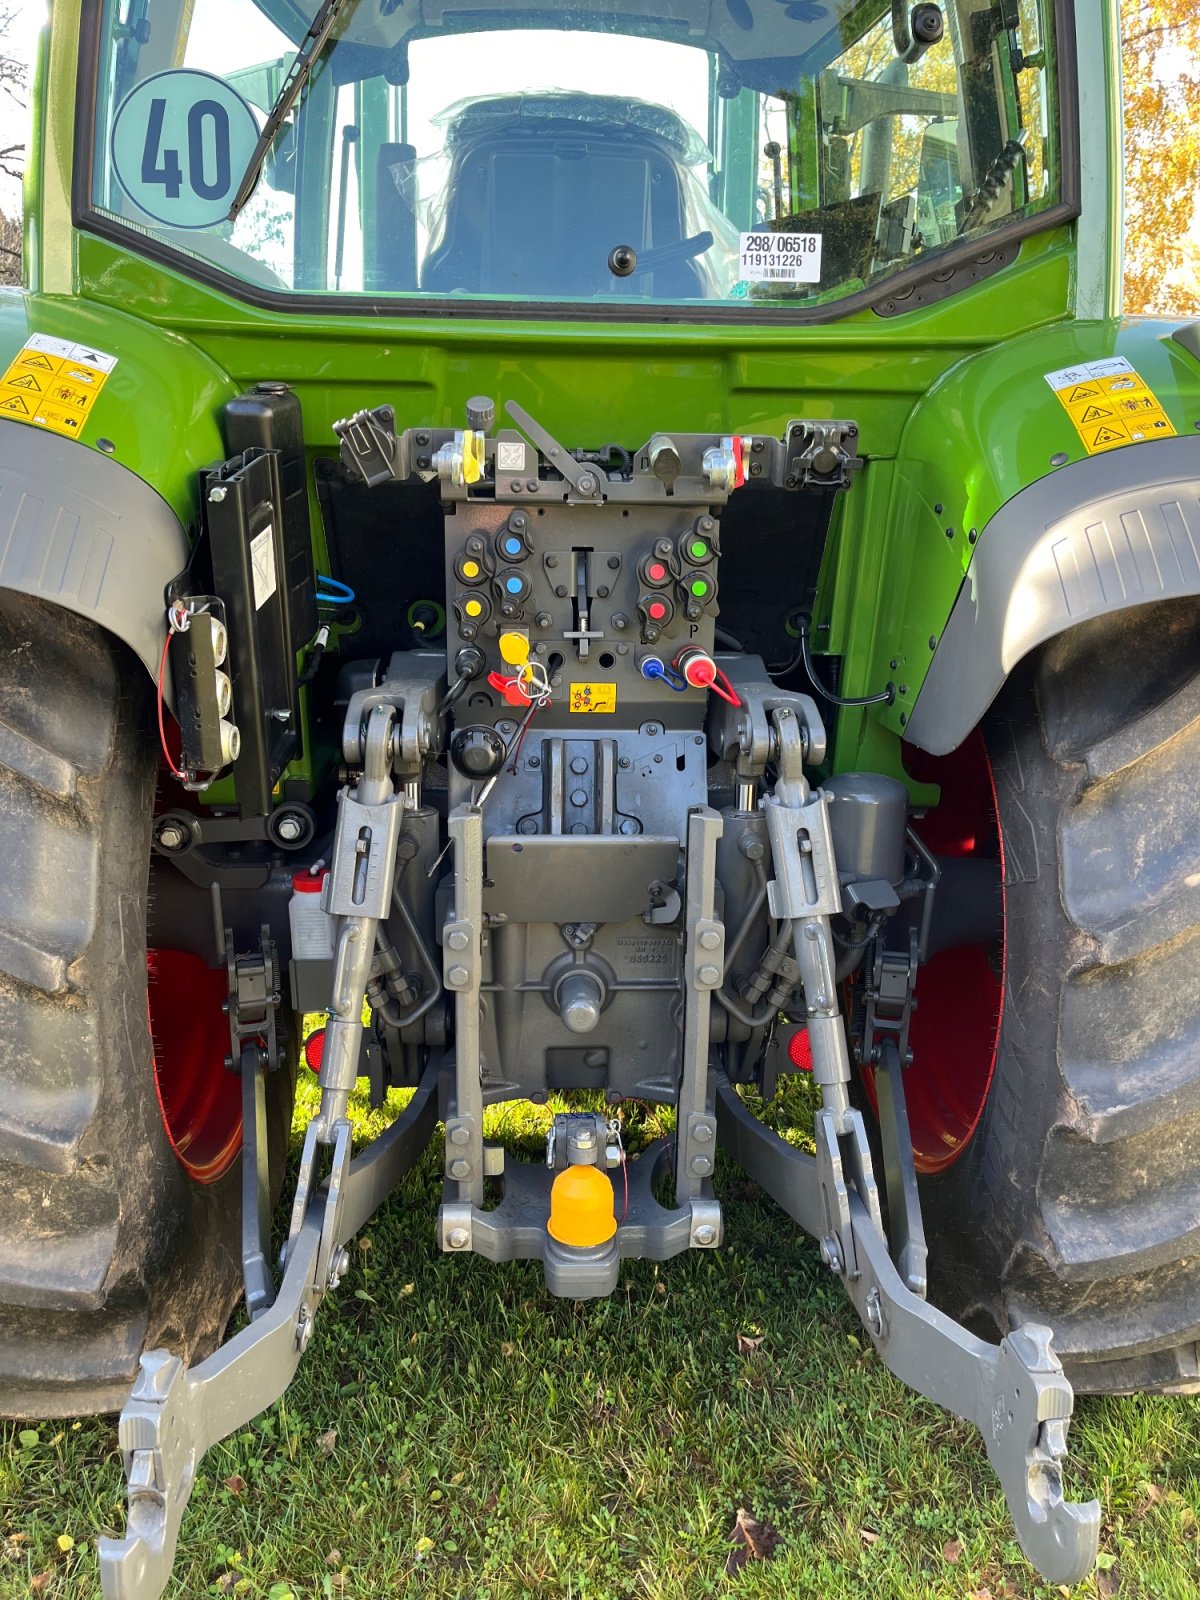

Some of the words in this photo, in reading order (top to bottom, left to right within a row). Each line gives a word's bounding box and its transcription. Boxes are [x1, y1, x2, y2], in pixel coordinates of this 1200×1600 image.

[141, 98, 231, 201] 40
[741, 253, 802, 267] 119131226
[689, 624, 699, 639] P
